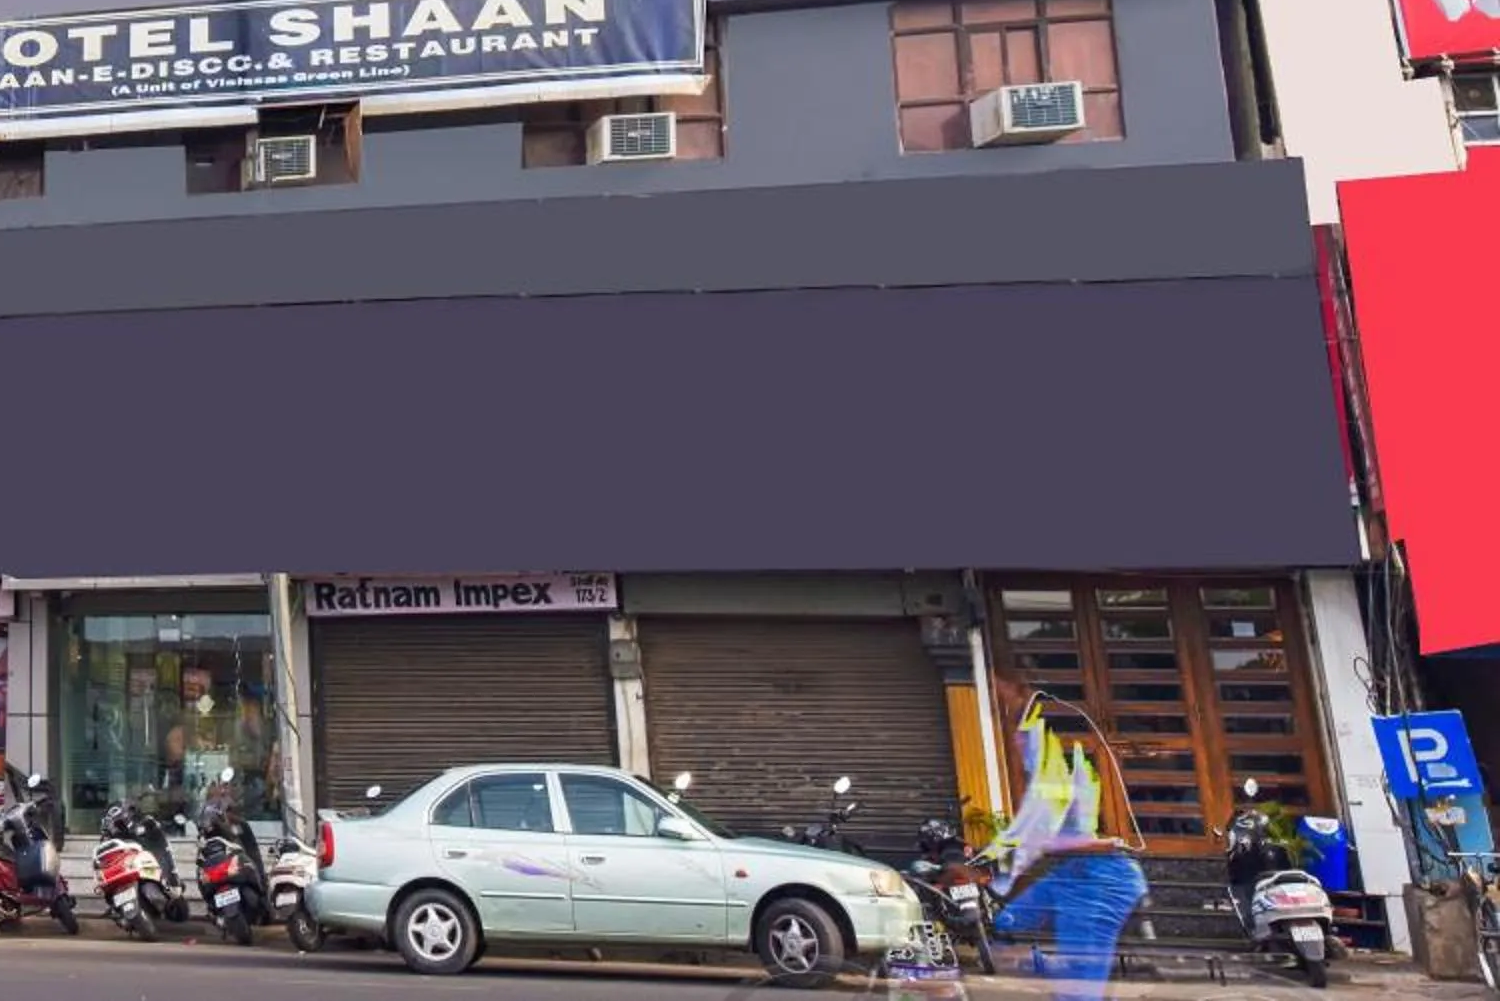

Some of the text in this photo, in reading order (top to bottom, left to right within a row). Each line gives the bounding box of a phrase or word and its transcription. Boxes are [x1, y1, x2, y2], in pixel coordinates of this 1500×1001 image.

[310, 28, 599, 67] RESTAURANT
[180, 79, 200, 91] of
[314, 578, 441, 611] Ratnam
[454, 579, 553, 609] Impex
[1396, 728, 1449, 783] P
